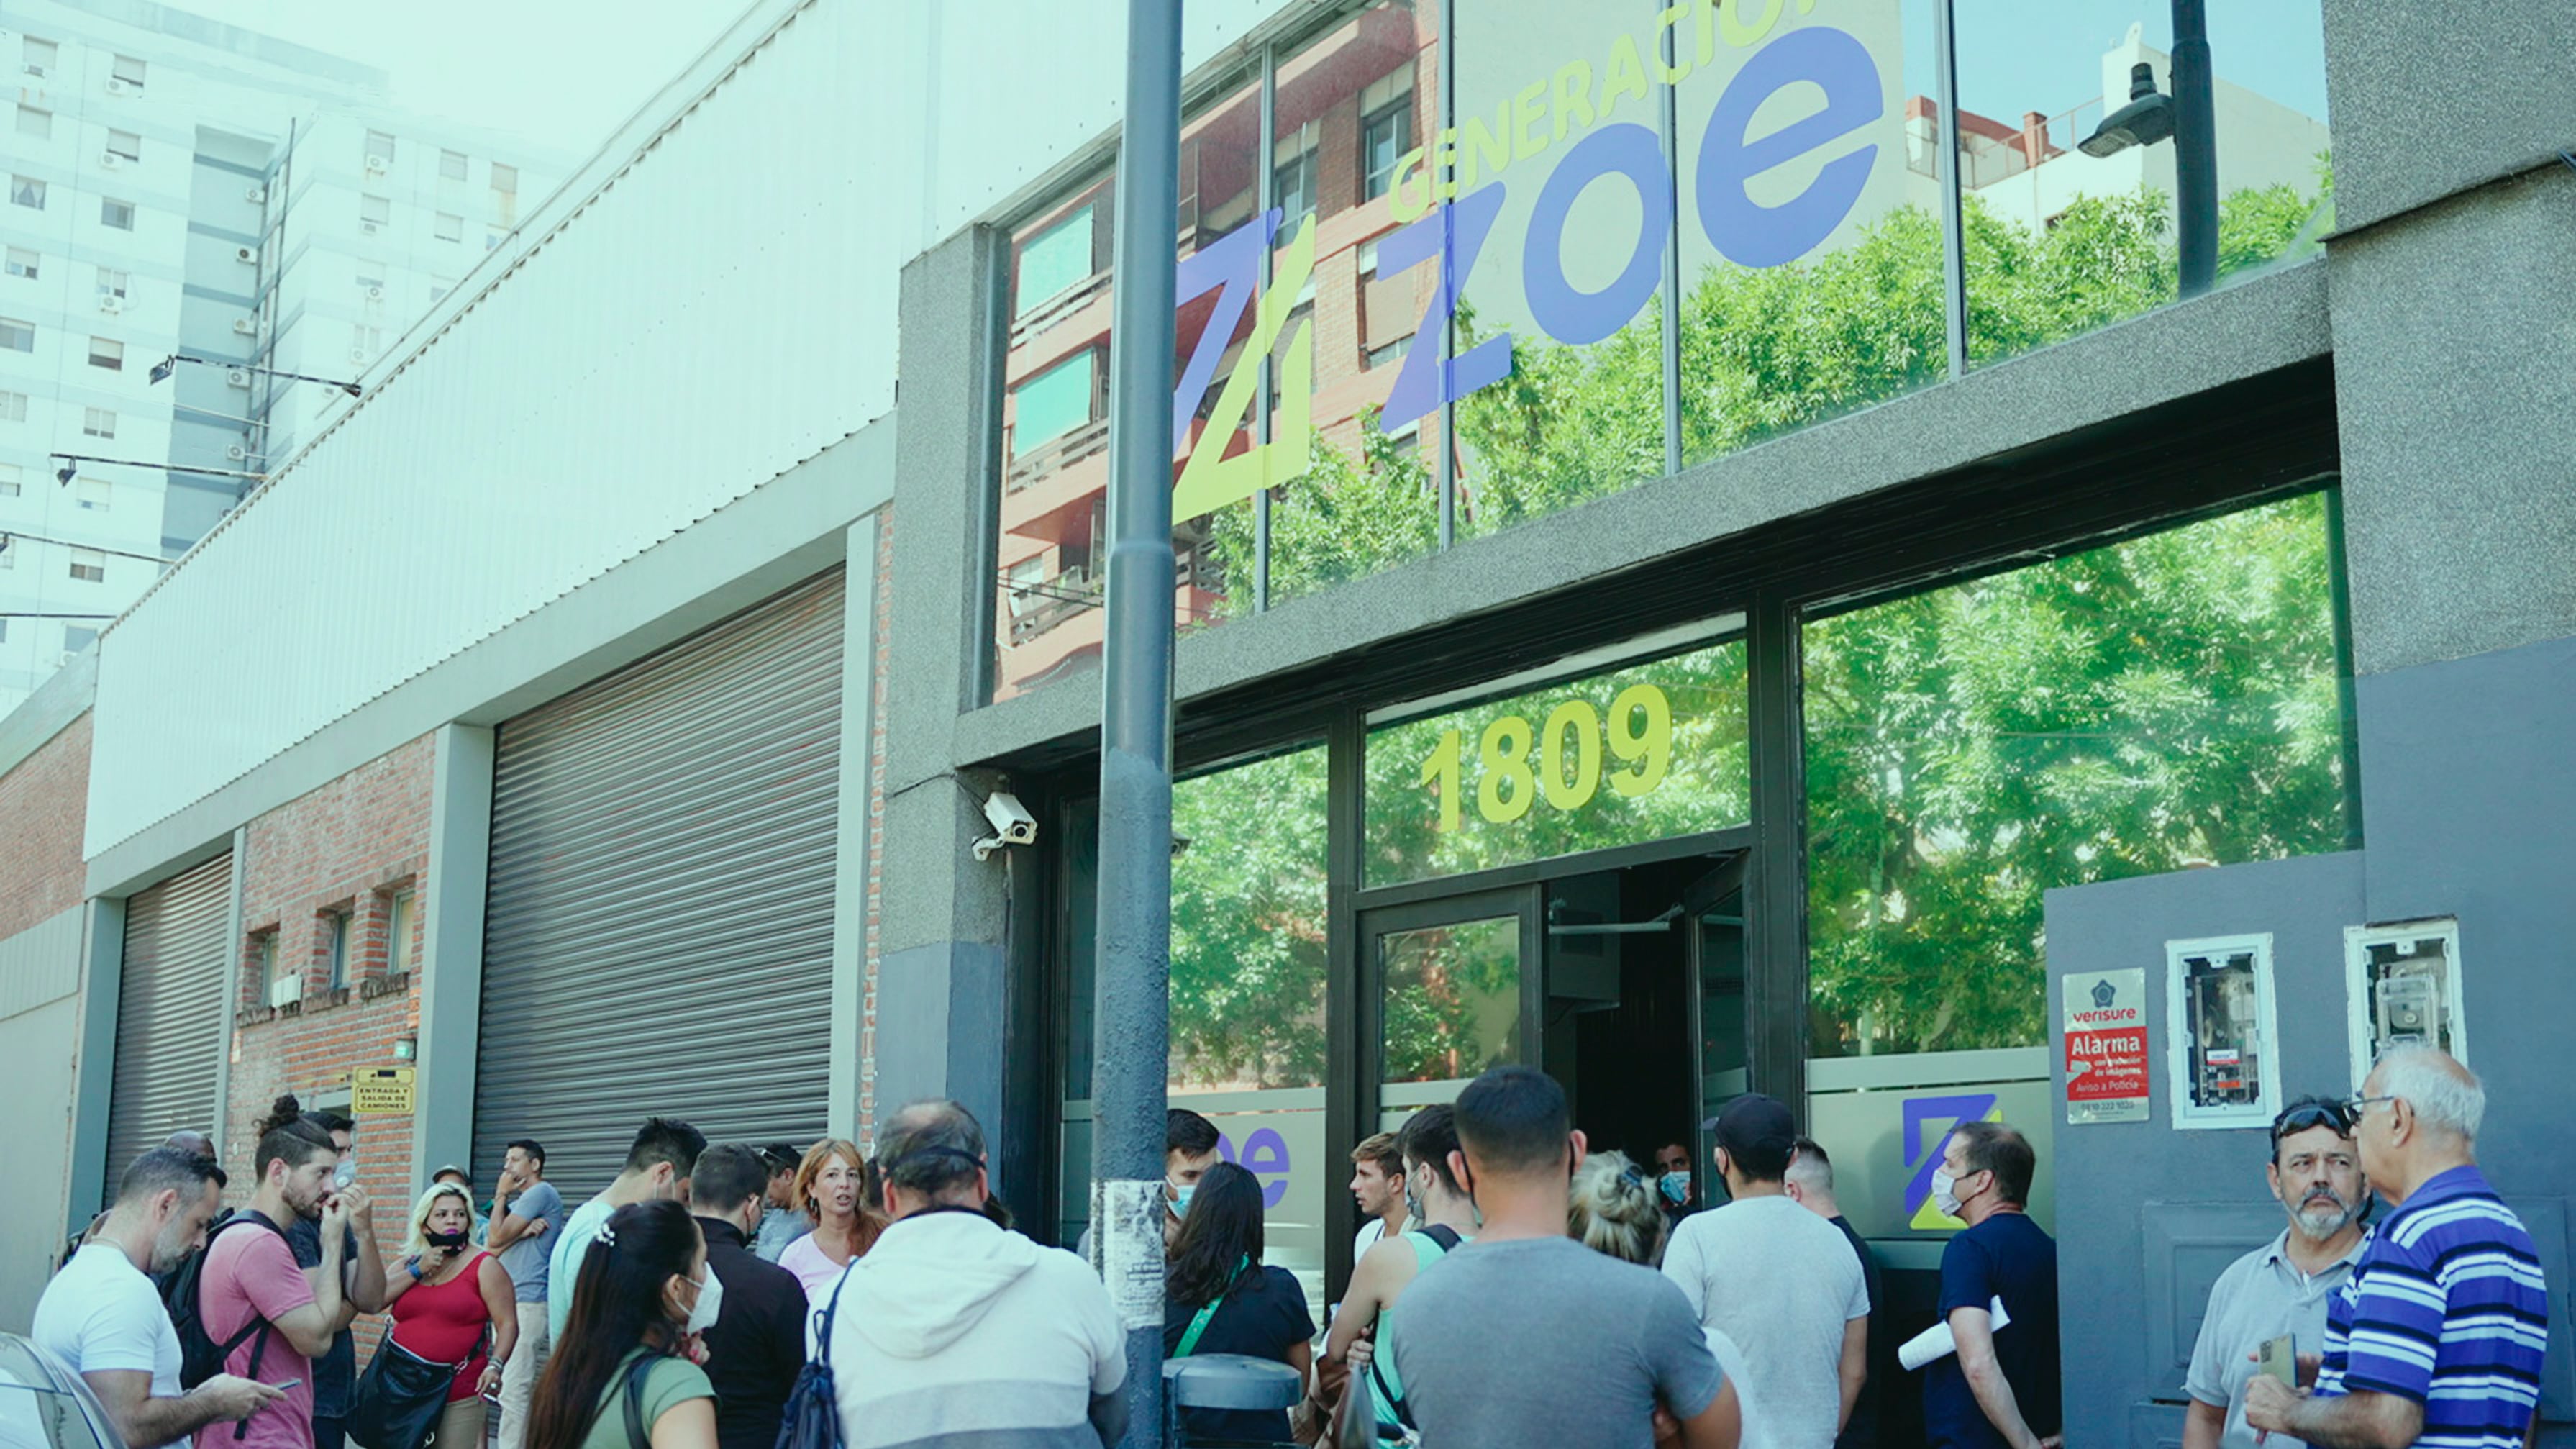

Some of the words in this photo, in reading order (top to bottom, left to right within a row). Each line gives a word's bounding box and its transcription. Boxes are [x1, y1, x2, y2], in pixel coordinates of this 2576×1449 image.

[1388, 0, 1816, 223] GENERACIO
[1375, 26, 1883, 432] zoe
[1421, 683, 1672, 833] 1809
[2072, 1008, 2136, 1022] verisure
[2072, 1035, 2141, 1055] Alarma
[2076, 1082, 2100, 1092] Aviso
